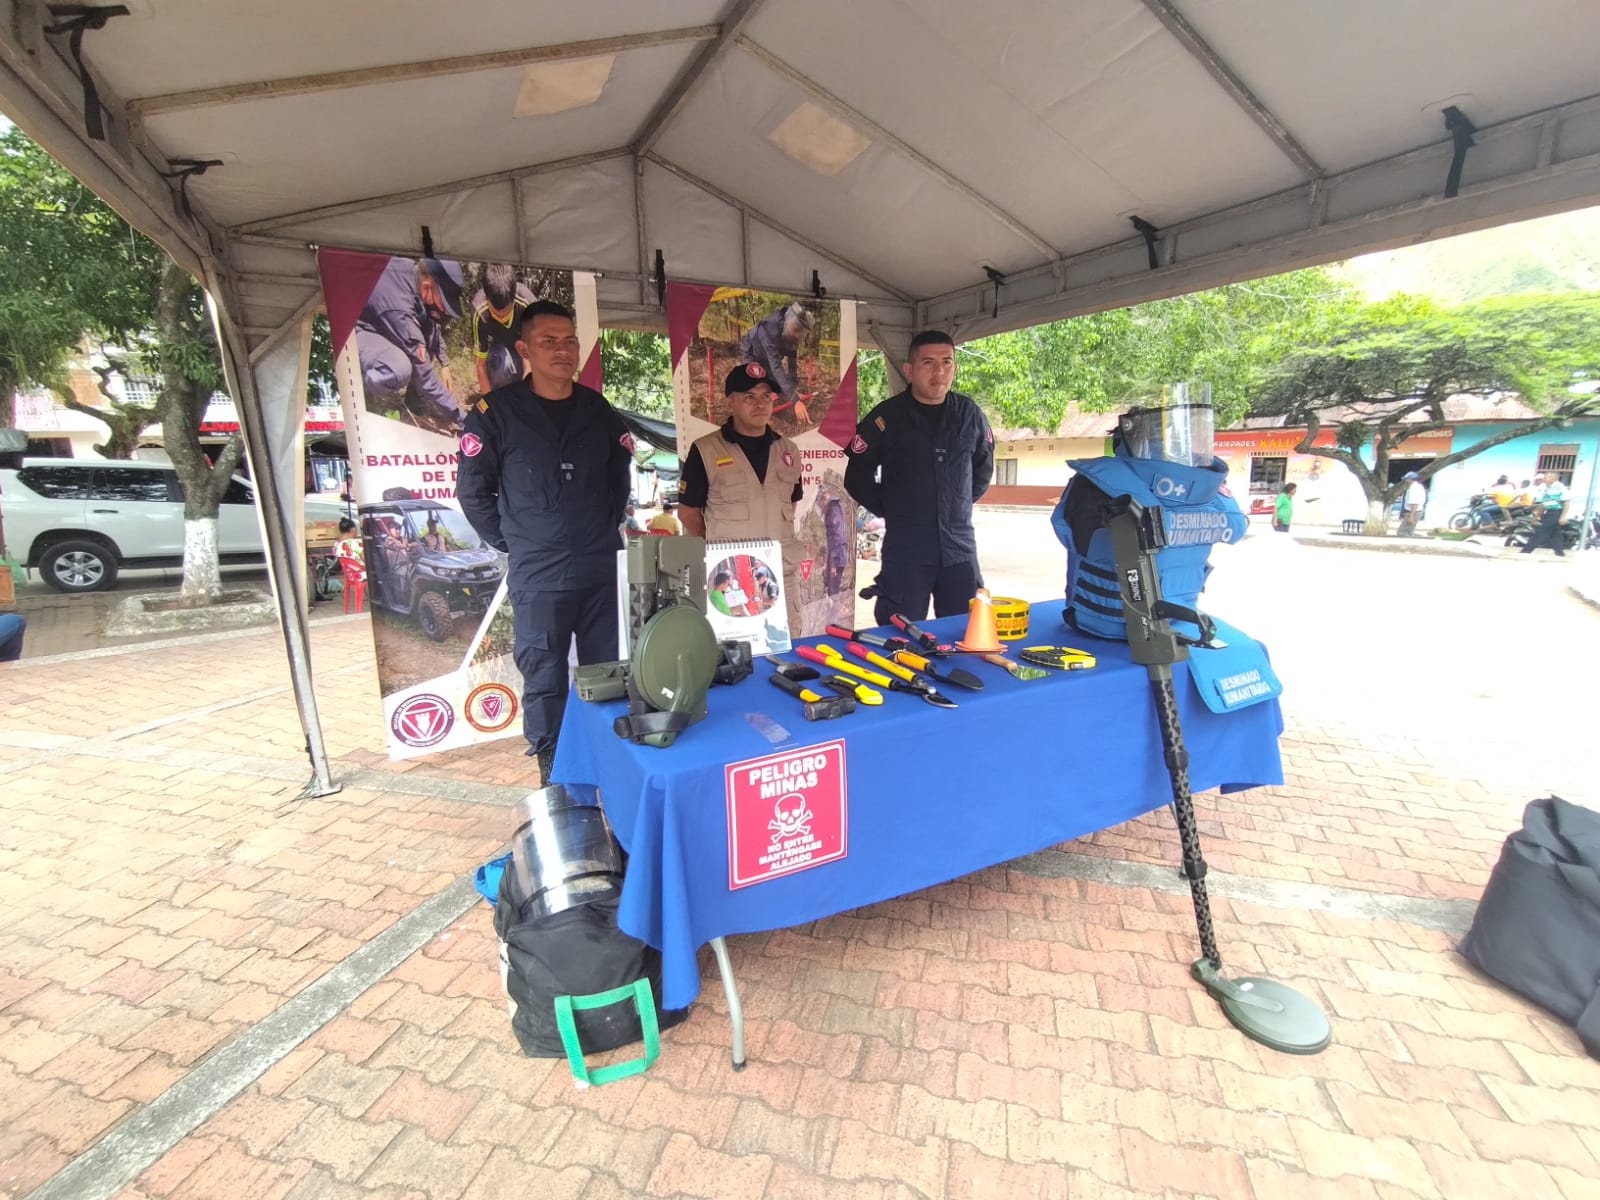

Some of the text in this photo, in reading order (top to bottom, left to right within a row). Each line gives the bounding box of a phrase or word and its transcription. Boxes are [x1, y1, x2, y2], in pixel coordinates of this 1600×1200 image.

[366, 452, 459, 467] BATALLÓN
[422, 471, 445, 482] DE
[1170, 512, 1228, 529] DESMINADO
[1127, 569, 1139, 582] F3
[749, 755, 826, 785] PELIGRO
[761, 772, 817, 799] MINAS
[768, 833, 815, 854] NO ENTRE
[770, 853, 812, 870] ALEJADO
